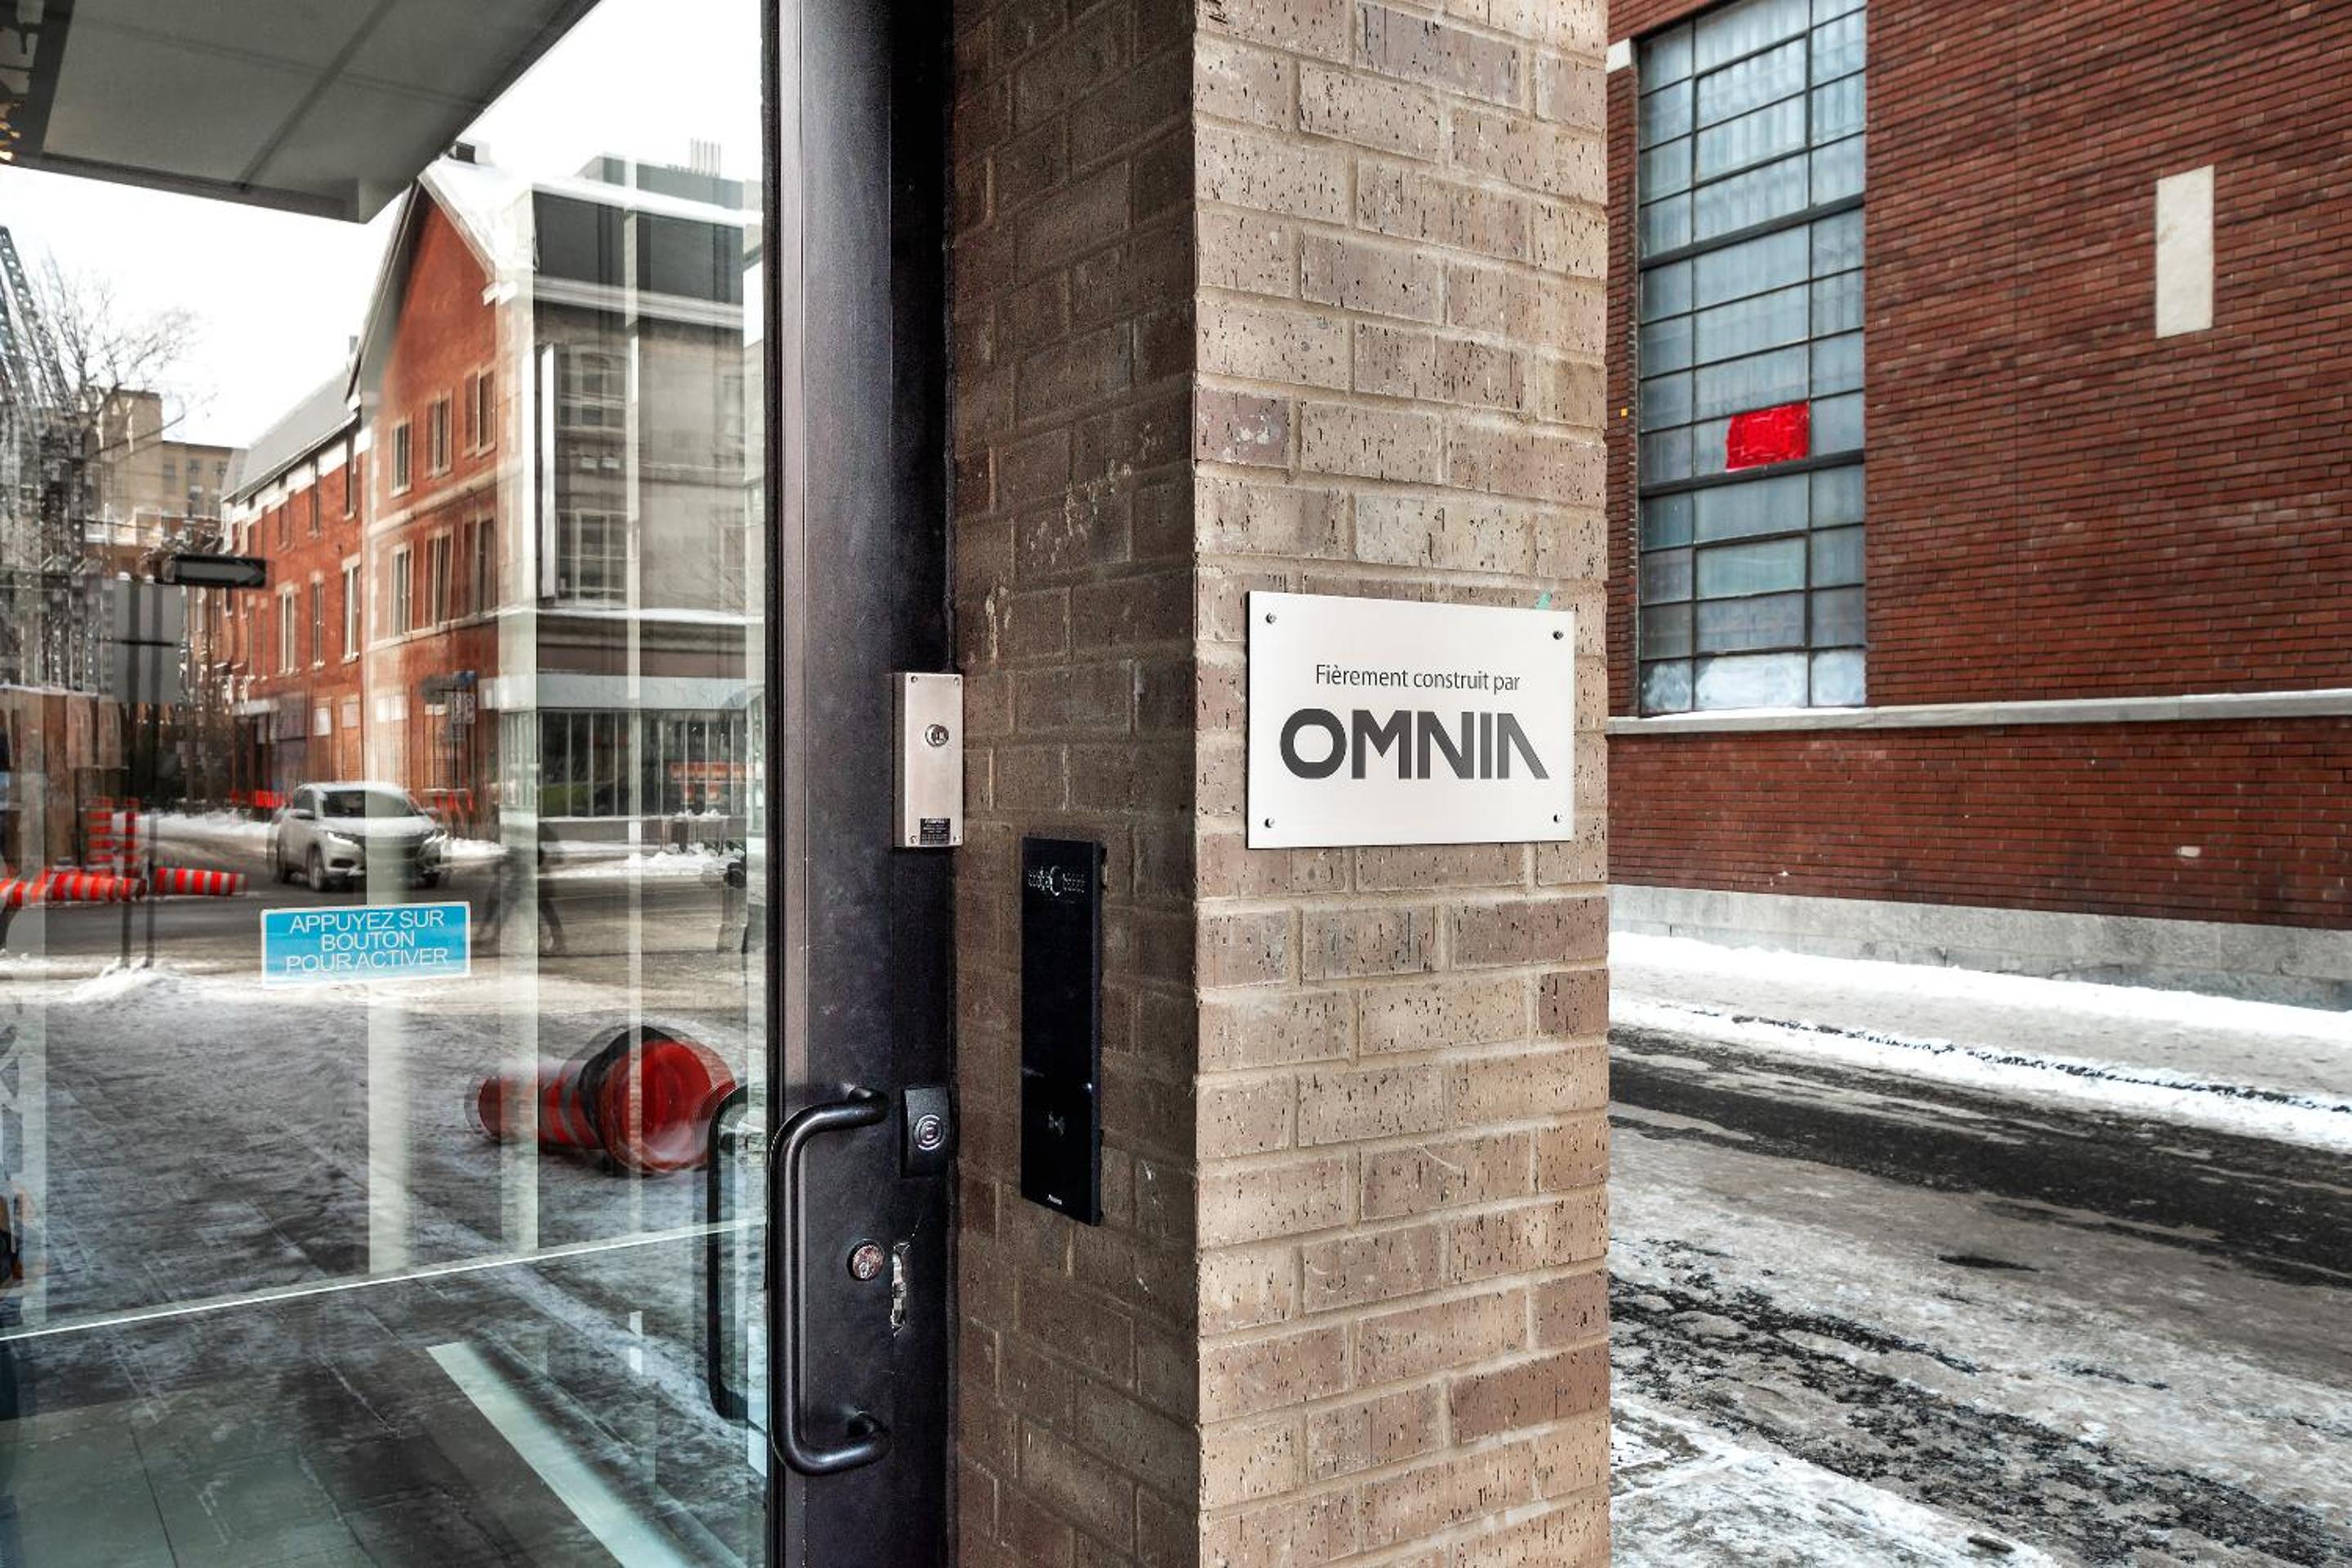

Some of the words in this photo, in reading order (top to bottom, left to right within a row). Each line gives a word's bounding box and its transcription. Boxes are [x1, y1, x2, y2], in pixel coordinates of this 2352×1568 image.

[1316, 665, 1409, 687] Fièrement
[1414, 670, 1489, 690] construit
[1494, 674, 1521, 695] par
[1281, 708, 1550, 779] OMNIA
[289, 911, 394, 934] APPUYEZ
[399, 910, 445, 929] SUR
[321, 930, 415, 951] BOUTON
[286, 952, 353, 973] POUR
[355, 947, 448, 969] ACTIVER
